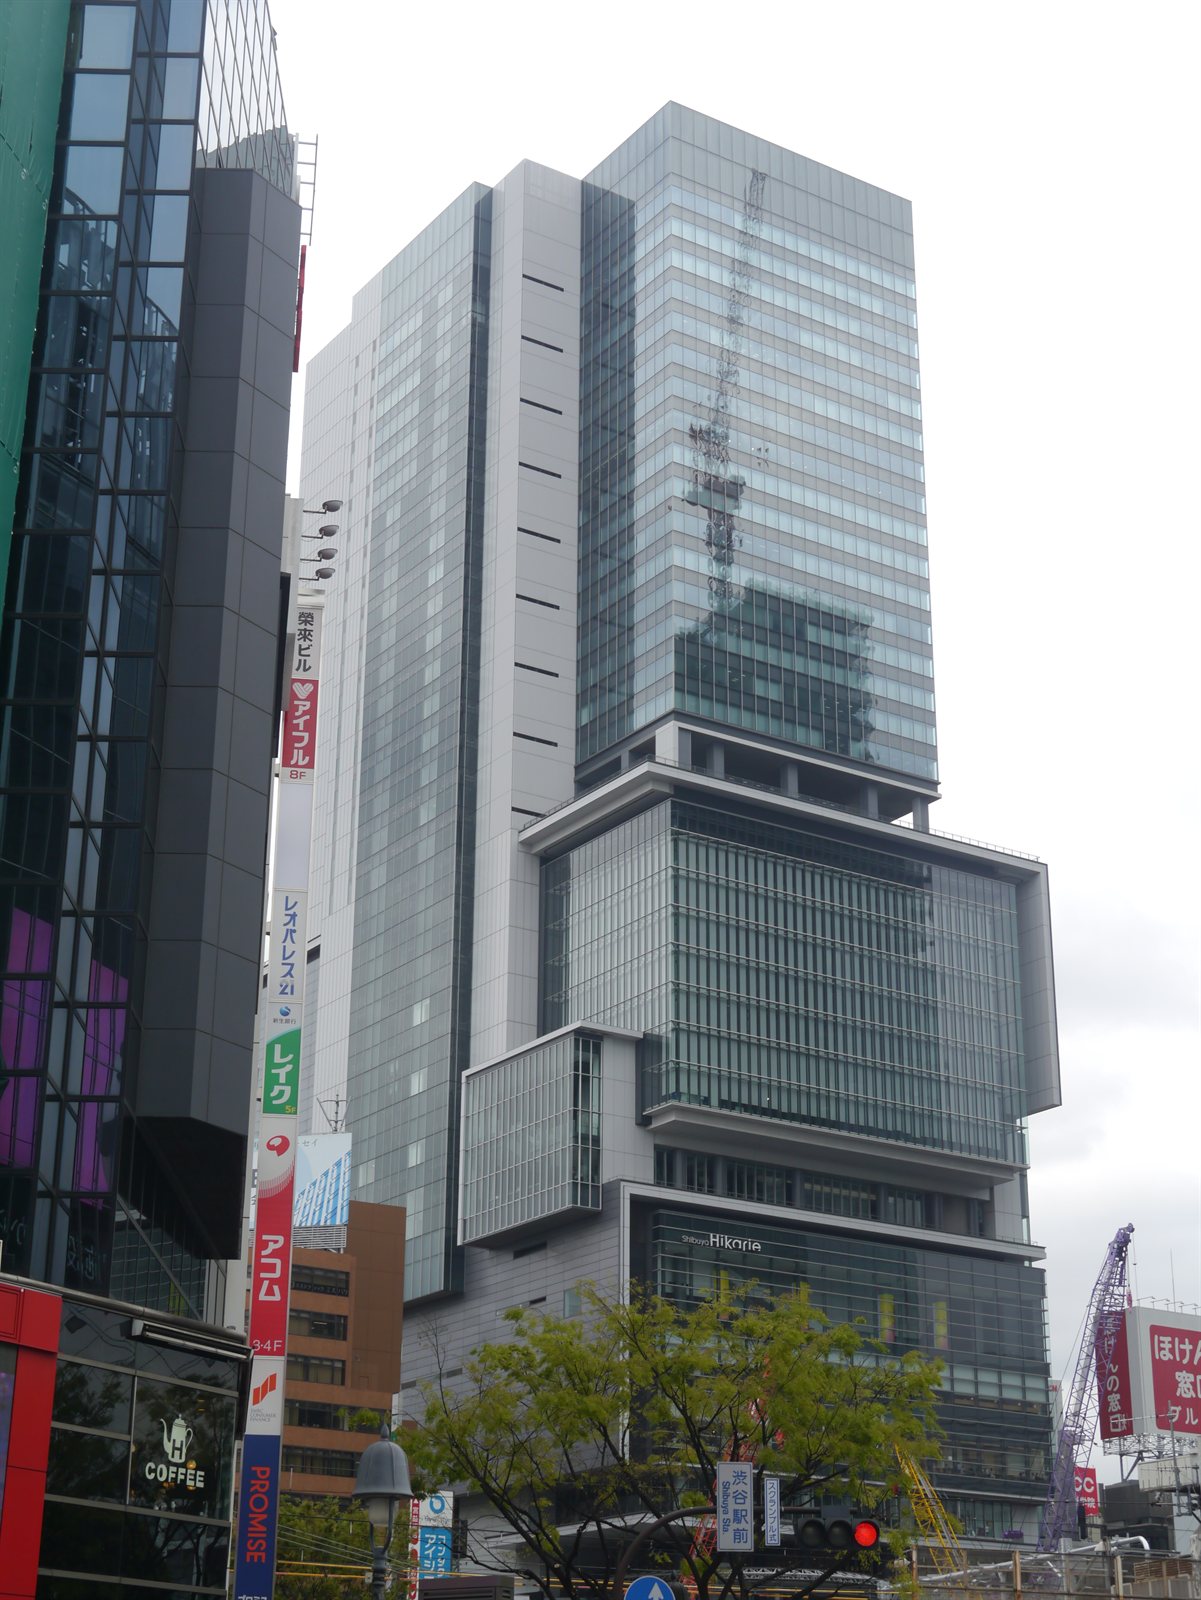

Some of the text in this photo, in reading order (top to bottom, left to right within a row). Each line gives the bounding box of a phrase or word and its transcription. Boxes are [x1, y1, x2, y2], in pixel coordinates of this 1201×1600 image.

[295, 611, 314, 673] 榮來ビル
[290, 701, 310, 766] アイフル
[289, 769, 306, 780] 8F
[278, 895, 298, 996] レオパレス21
[270, 1044, 294, 1105] レイク
[285, 1105, 296, 1114] 5F
[259, 1235, 285, 1302] アコム
[682, 1232, 762, 1252] Shibuya Hikarie
[1175, 1370, 1201, 1399] 窓
[145, 1461, 205, 1489] COFFEE
[246, 1466, 271, 1563] PROMISE
[721, 1481, 731, 1536] Shibuya Sta.
[732, 1469, 749, 1545] 渋谷駅前
[768, 1481, 777, 1543] スクランブル式
